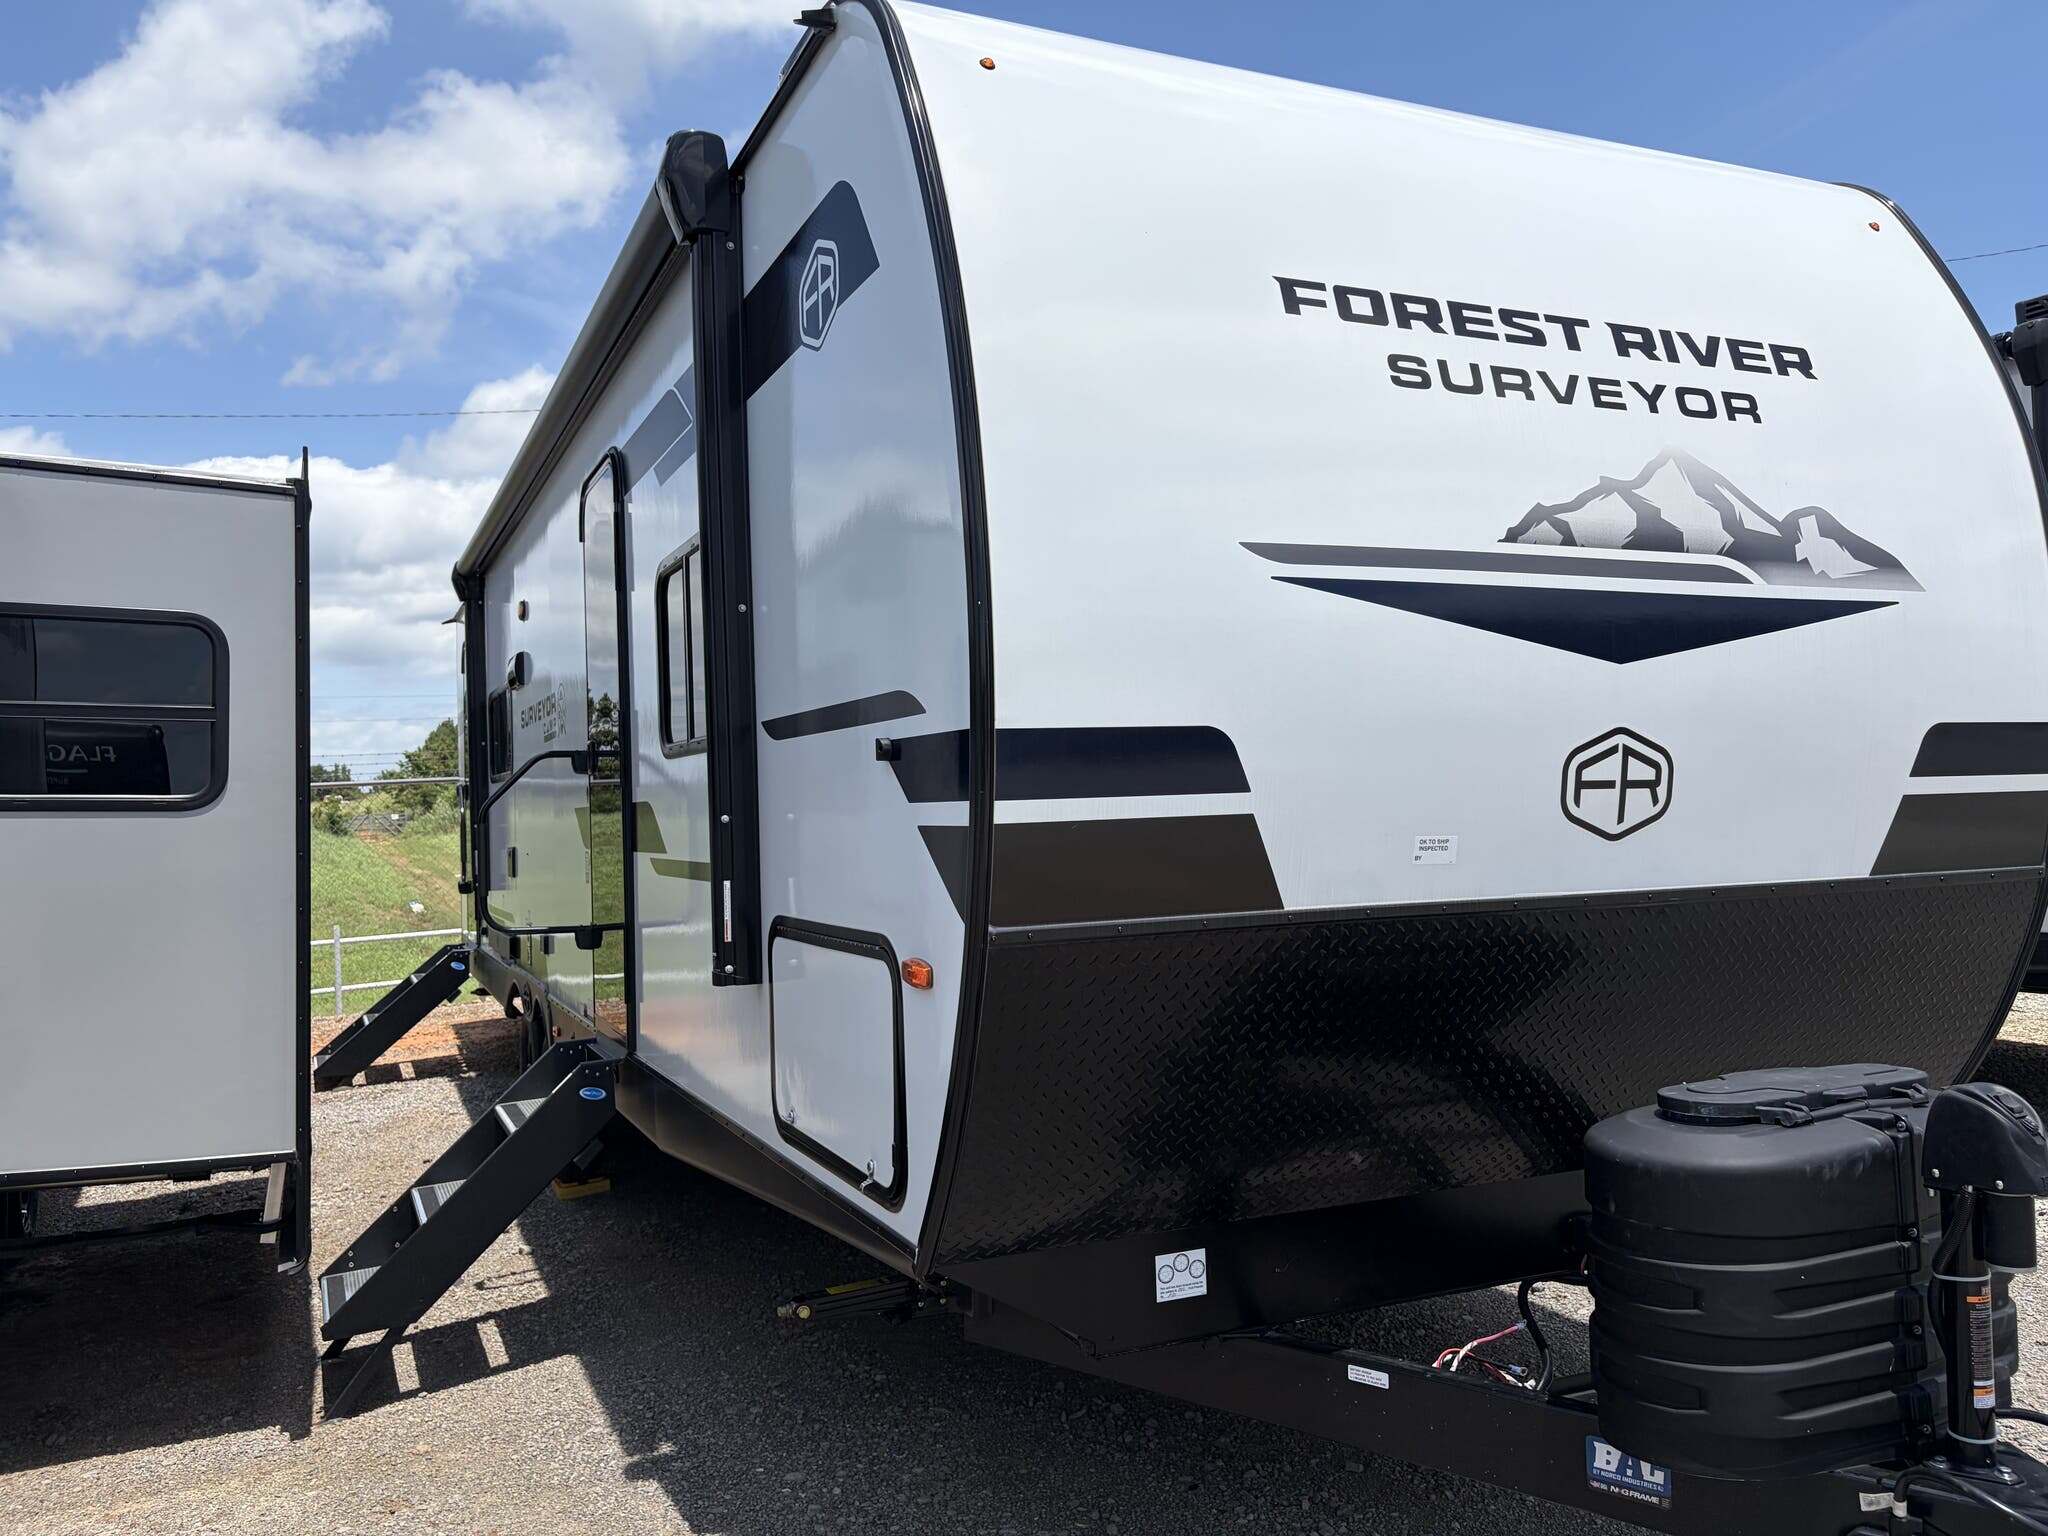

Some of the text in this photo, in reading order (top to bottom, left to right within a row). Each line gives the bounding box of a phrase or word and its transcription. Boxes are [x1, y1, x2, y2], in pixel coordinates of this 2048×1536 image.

[1272, 275, 1818, 380] FOREST RIVER
[1388, 352, 1763, 424] SURVEYOR
[520, 691, 557, 729] SURVEYOR
[1593, 1441, 1665, 1485] BAL
[1622, 1475, 1658, 1490] INDUSTRIES
